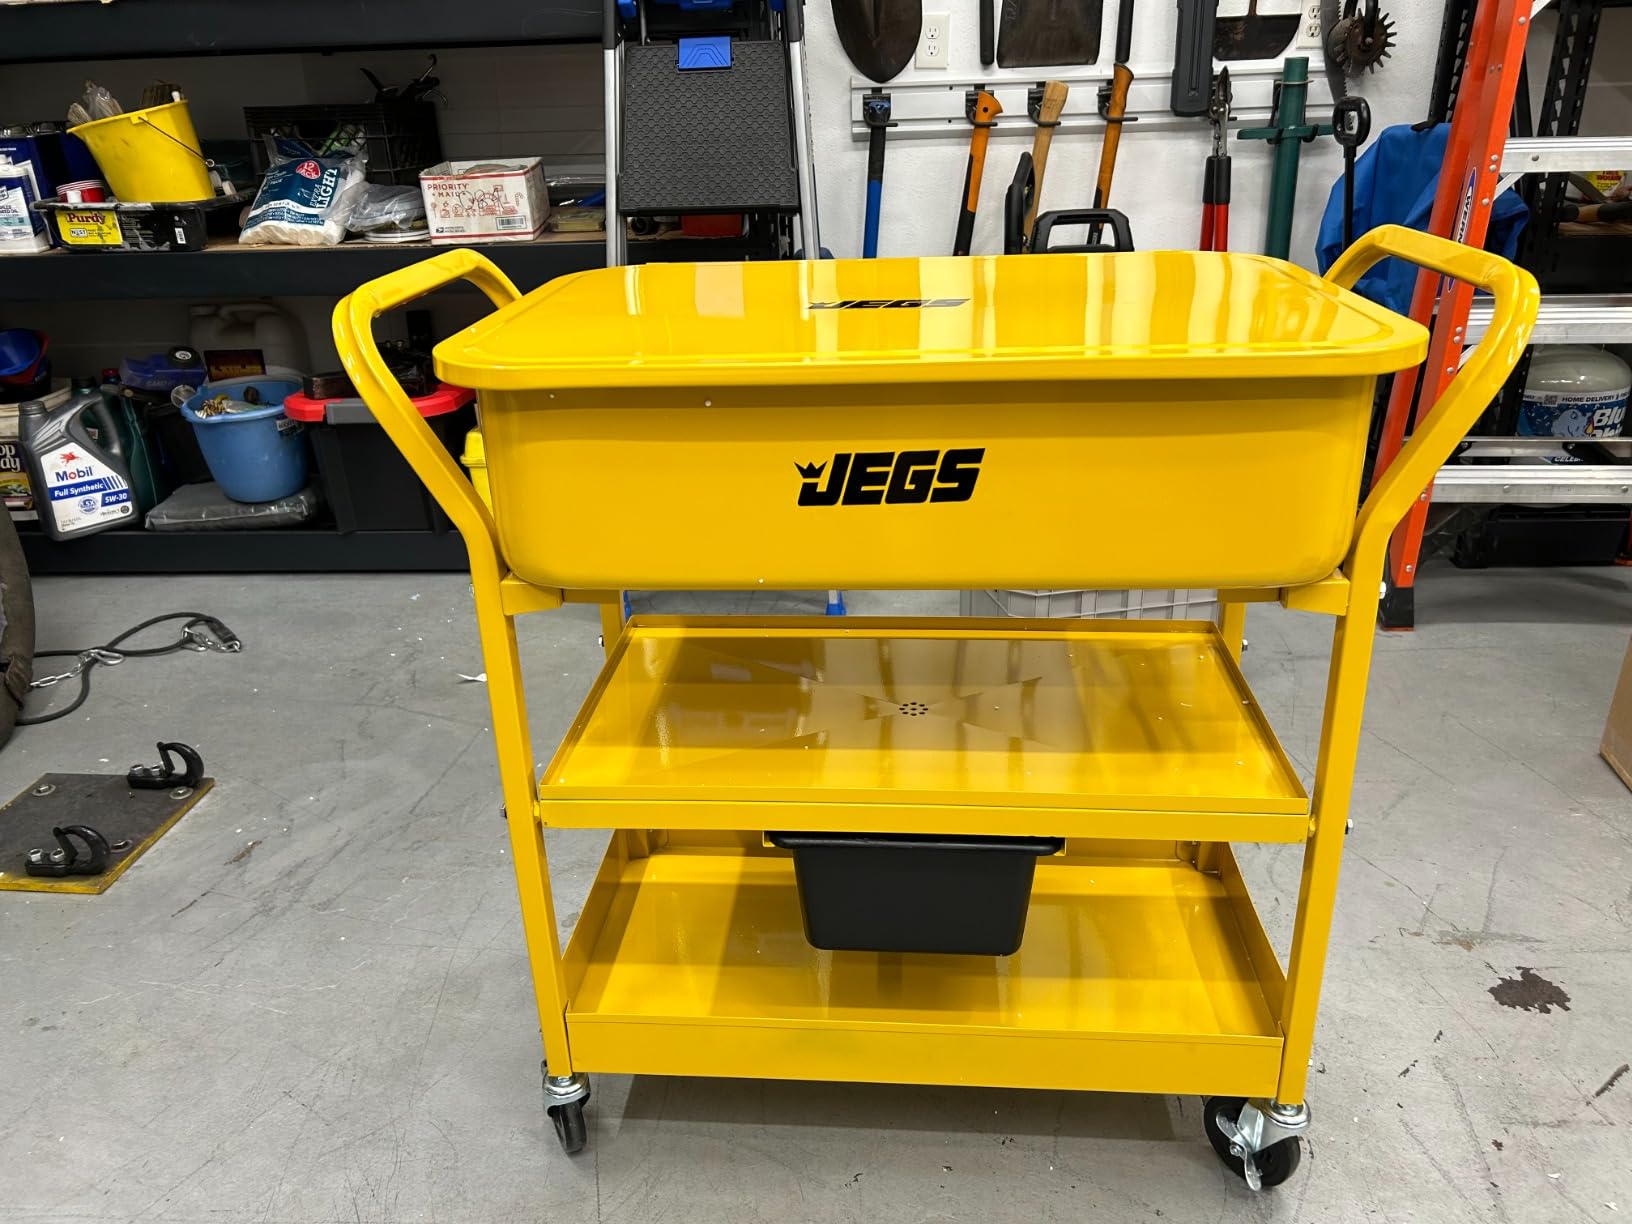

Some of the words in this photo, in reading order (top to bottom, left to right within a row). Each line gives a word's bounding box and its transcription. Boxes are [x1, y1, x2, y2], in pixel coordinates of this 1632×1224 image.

[315, 167, 338, 209] LIGHT
[427, 183, 468, 191] PRIORITY
[65, 212, 106, 225] Purdy
[55, 466, 94, 482] Mobil
[796, 448, 986, 507] JEGS
[54, 488, 69, 498] Full
[69, 482, 104, 496] Synthetic
[104, 492, 128, 504] 5W-30
